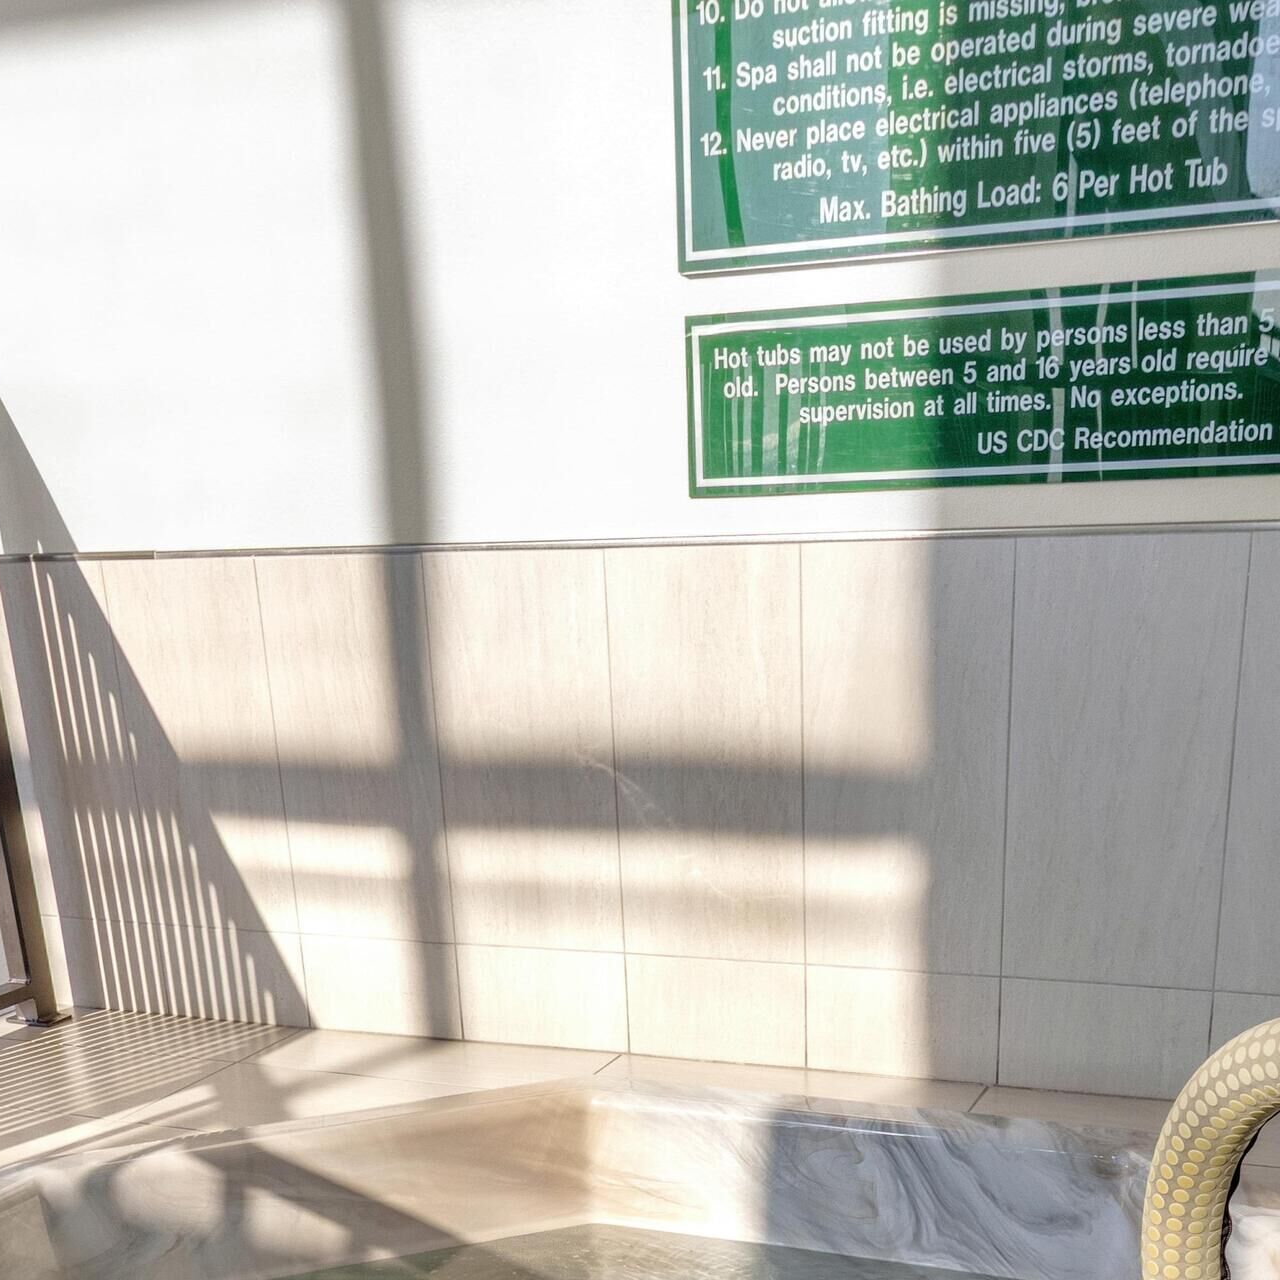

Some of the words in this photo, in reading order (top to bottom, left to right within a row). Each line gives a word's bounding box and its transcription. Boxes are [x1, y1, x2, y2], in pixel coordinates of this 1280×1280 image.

[696, 0, 725, 25] 10.
[734, 0, 764, 20] Do
[772, 18, 852, 49] suction
[863, 7, 928, 36] fitting
[938, 2, 957, 26] is
[969, 0, 1065, 22] missing,
[703, 66, 726, 91] 11.
[736, 61, 777, 88] Spa
[787, 51, 836, 81] shall
[846, 49, 882, 76] not
[892, 42, 920, 69] be
[931, 24, 1036, 65] operated
[1046, 16, 1122, 47] during
[1133, 5, 1217, 36] severe
[700, 132, 727, 156] 12.
[736, 126, 797, 153] Never
[806, 118, 865, 148] place
[875, 101, 980, 137] electrical
[990, 87, 1118, 127] appliances
[1130, 71, 1271, 110] (telephone,
[773, 82, 892, 116] conditions,
[902, 75, 934, 100] i.e.
[944, 57, 1052, 96] electrical
[1063, 52, 1154, 82] storms,
[773, 155, 831, 181] radio,
[842, 152, 867, 175] tv,
[877, 148, 927, 170] etc.)
[937, 136, 1003, 164] within
[1014, 129, 1056, 154] five
[1067, 118, 1100, 152] (5)
[1112, 117, 1161, 145] feet
[1172, 110, 1198, 138] of
[1209, 105, 1248, 134] the
[820, 197, 870, 224] Max.
[881, 187, 966, 218] Bathing
[977, 176, 1041, 209] Load:
[1052, 174, 1068, 201] 6
[1079, 171, 1119, 196] Per
[1129, 163, 1173, 193] Hot
[1185, 157, 1228, 188] Tub
[714, 347, 748, 369] Hot
[757, 344, 800, 366] tubs
[809, 344, 851, 369] may
[860, 338, 894, 360] not
[903, 335, 929, 357] be
[939, 329, 991, 355] used
[1000, 327, 1027, 353] by
[1036, 324, 1127, 352] persons
[1138, 317, 1185, 342] less
[1196, 312, 1248, 338] than
[1258, 308, 1274, 332] 5
[724, 376, 758, 399] old.
[776, 372, 856, 395] Persons
[864, 366, 953, 390] between
[963, 362, 977, 384] 5
[987, 359, 1026, 382] and
[1035, 356, 1059, 379] 16
[1069, 356, 1130, 382] years
[1141, 348, 1176, 375] old
[1186, 344, 1269, 374] require
[800, 397, 915, 425] supervision
[924, 395, 944, 417] at
[953, 392, 977, 416] all
[987, 392, 1051, 414] times.
[1070, 384, 1101, 409] No
[1111, 380, 1243, 409] exceptions.
[977, 430, 1007, 455] US
[1017, 428, 1064, 453] CDC
[1074, 420, 1272, 450] Recommendation
